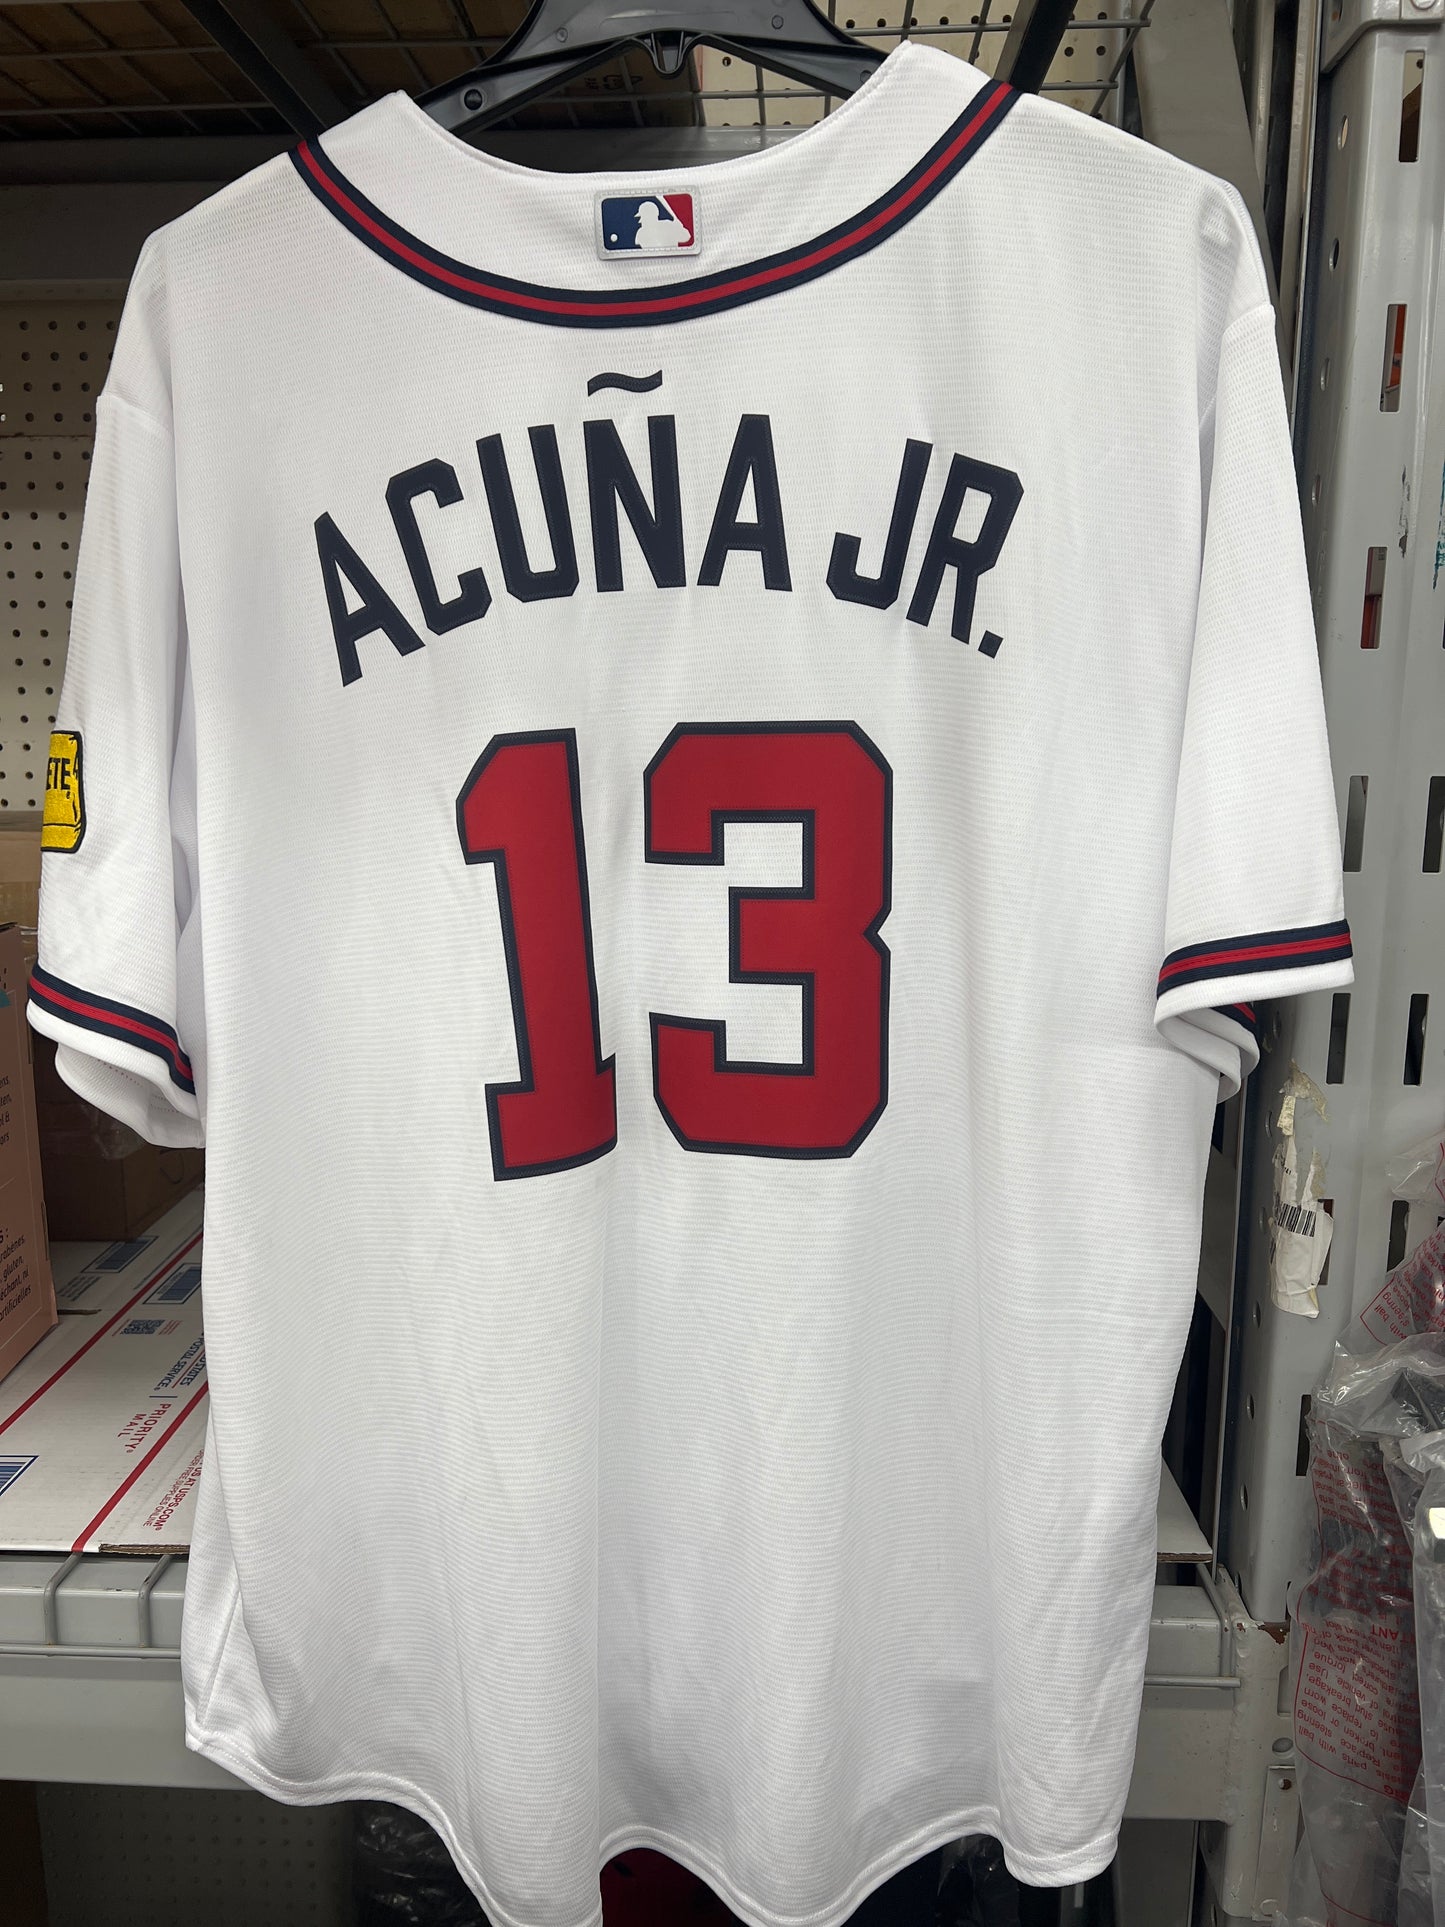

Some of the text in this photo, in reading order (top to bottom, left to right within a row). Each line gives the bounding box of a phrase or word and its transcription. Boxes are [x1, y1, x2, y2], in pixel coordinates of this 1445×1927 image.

[313, 369, 1024, 688] ACUÑA JR.
[456, 720, 894, 1181] 13
[118, 1413, 147, 1438] MAIL
[1301, 1699, 1326, 1720] loose
[1331, 1703, 1362, 1729] replace
[1297, 1709, 1332, 1738] steering
[1298, 1726, 1315, 1743] ball
